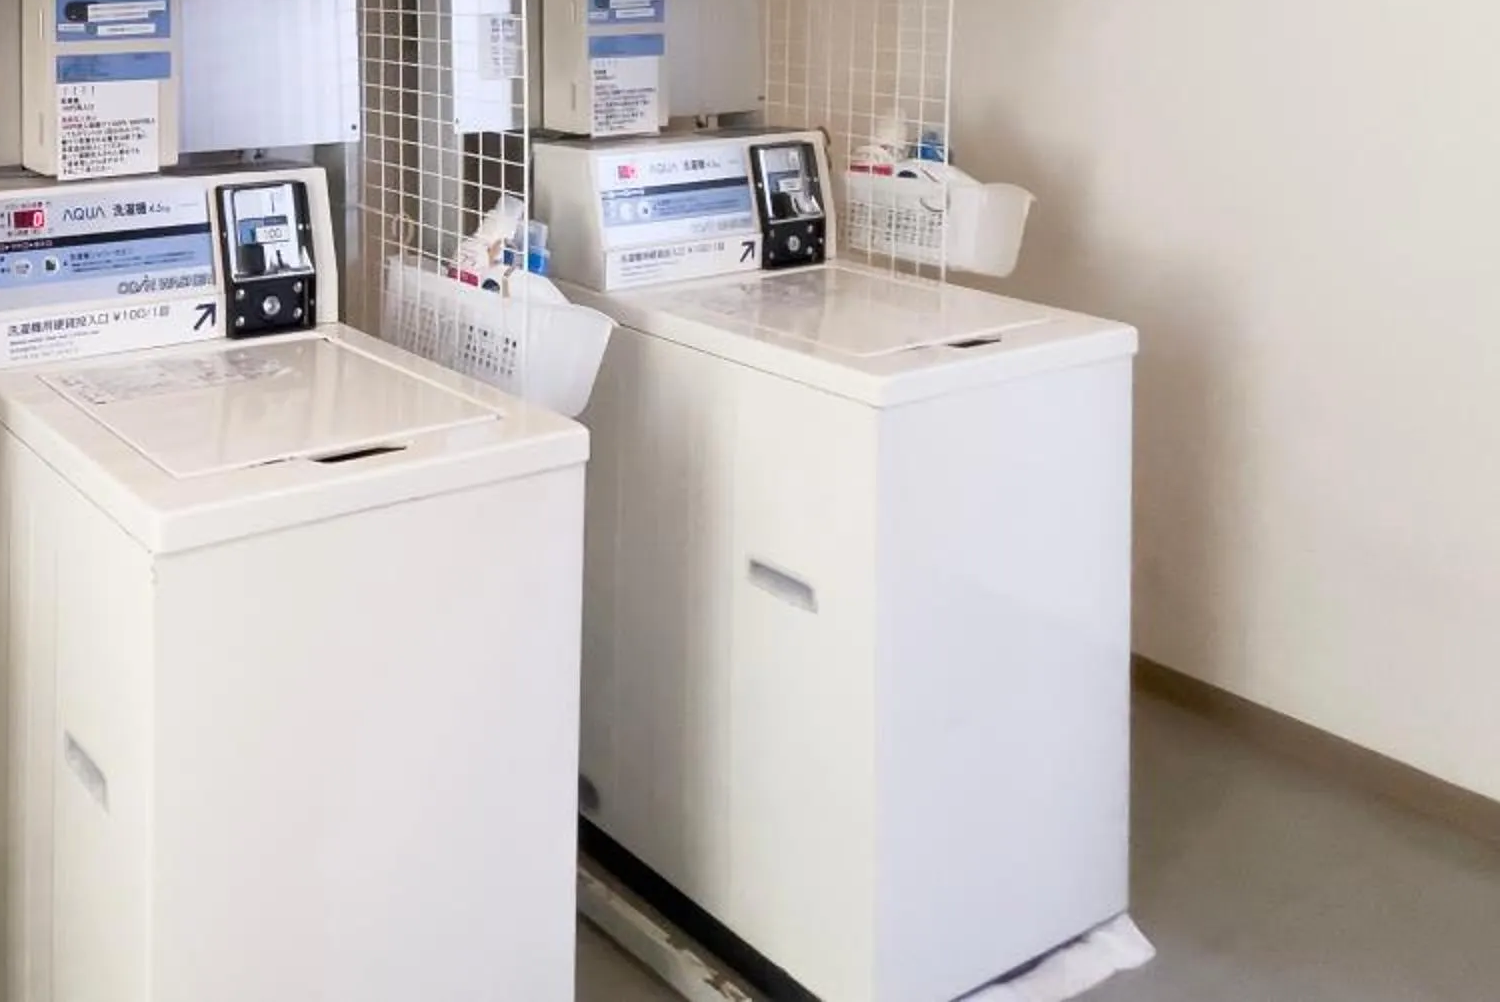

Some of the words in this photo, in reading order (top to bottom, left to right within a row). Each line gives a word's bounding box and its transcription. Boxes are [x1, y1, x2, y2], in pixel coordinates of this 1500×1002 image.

[62, 205, 106, 222] AQUA
[112, 201, 148, 217] 洗濯機
